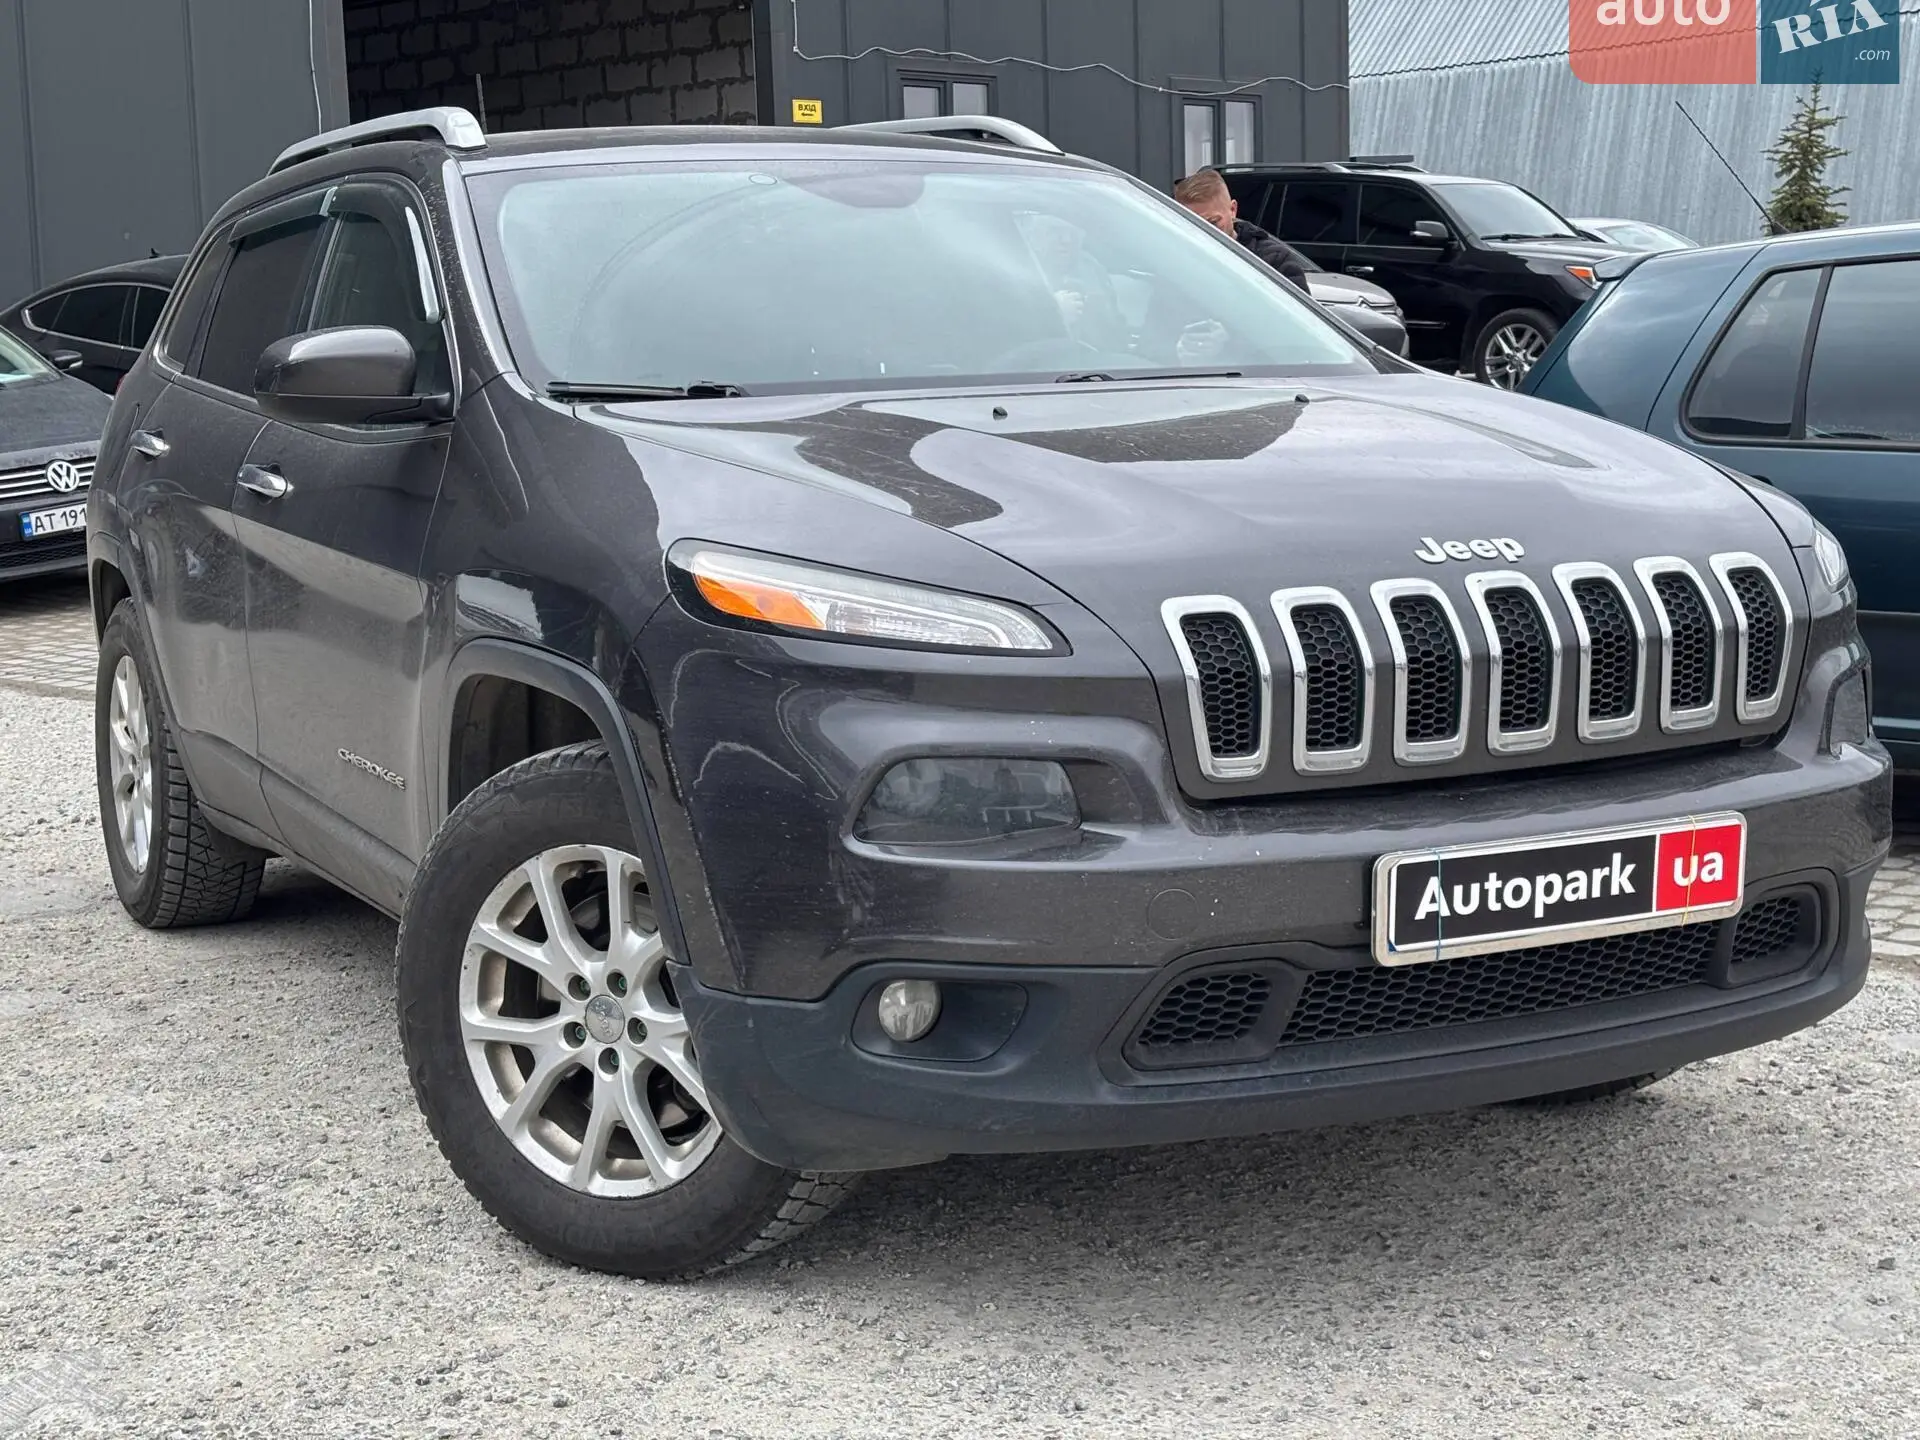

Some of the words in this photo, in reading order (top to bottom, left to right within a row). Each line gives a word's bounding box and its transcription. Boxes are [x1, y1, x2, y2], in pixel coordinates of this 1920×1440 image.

[34, 512, 56, 533] AT
[1414, 536, 1525, 564] Jeep
[1414, 852, 1637, 921] Autopark
[1673, 851, 1724, 887] ua
